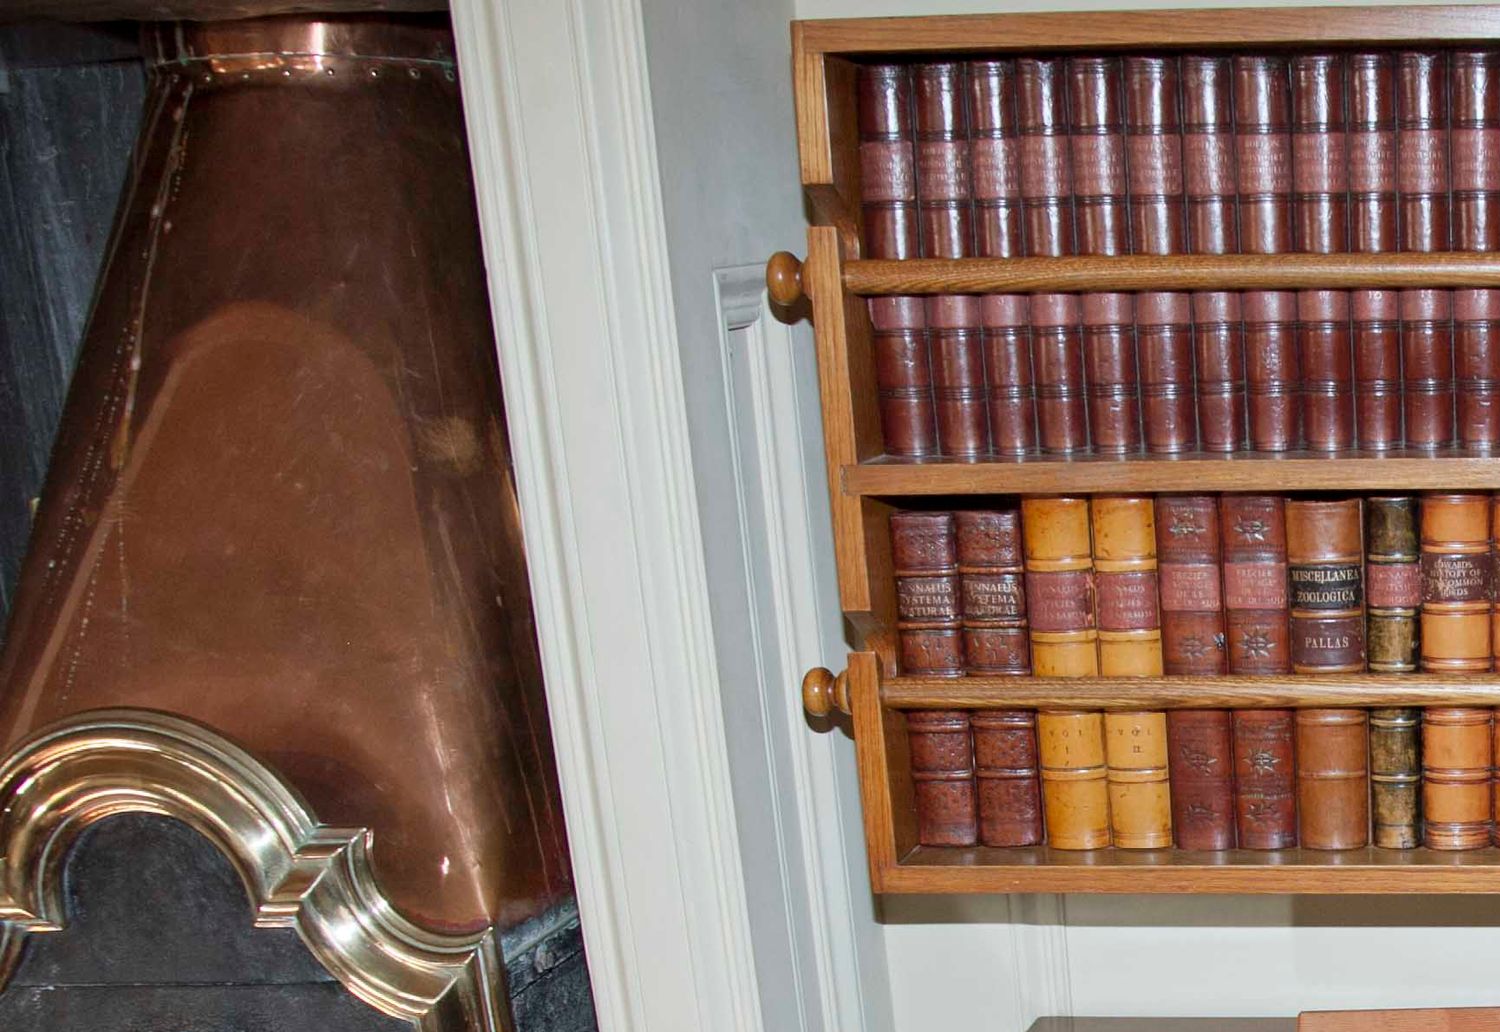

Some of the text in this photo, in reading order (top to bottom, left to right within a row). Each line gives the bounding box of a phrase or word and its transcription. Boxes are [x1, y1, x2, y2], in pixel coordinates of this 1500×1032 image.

[1292, 569, 1359, 583] MISCELLANEA
[1297, 590, 1355, 603] ZOOLOGICA
[1305, 637, 1350, 649] PALLAS
